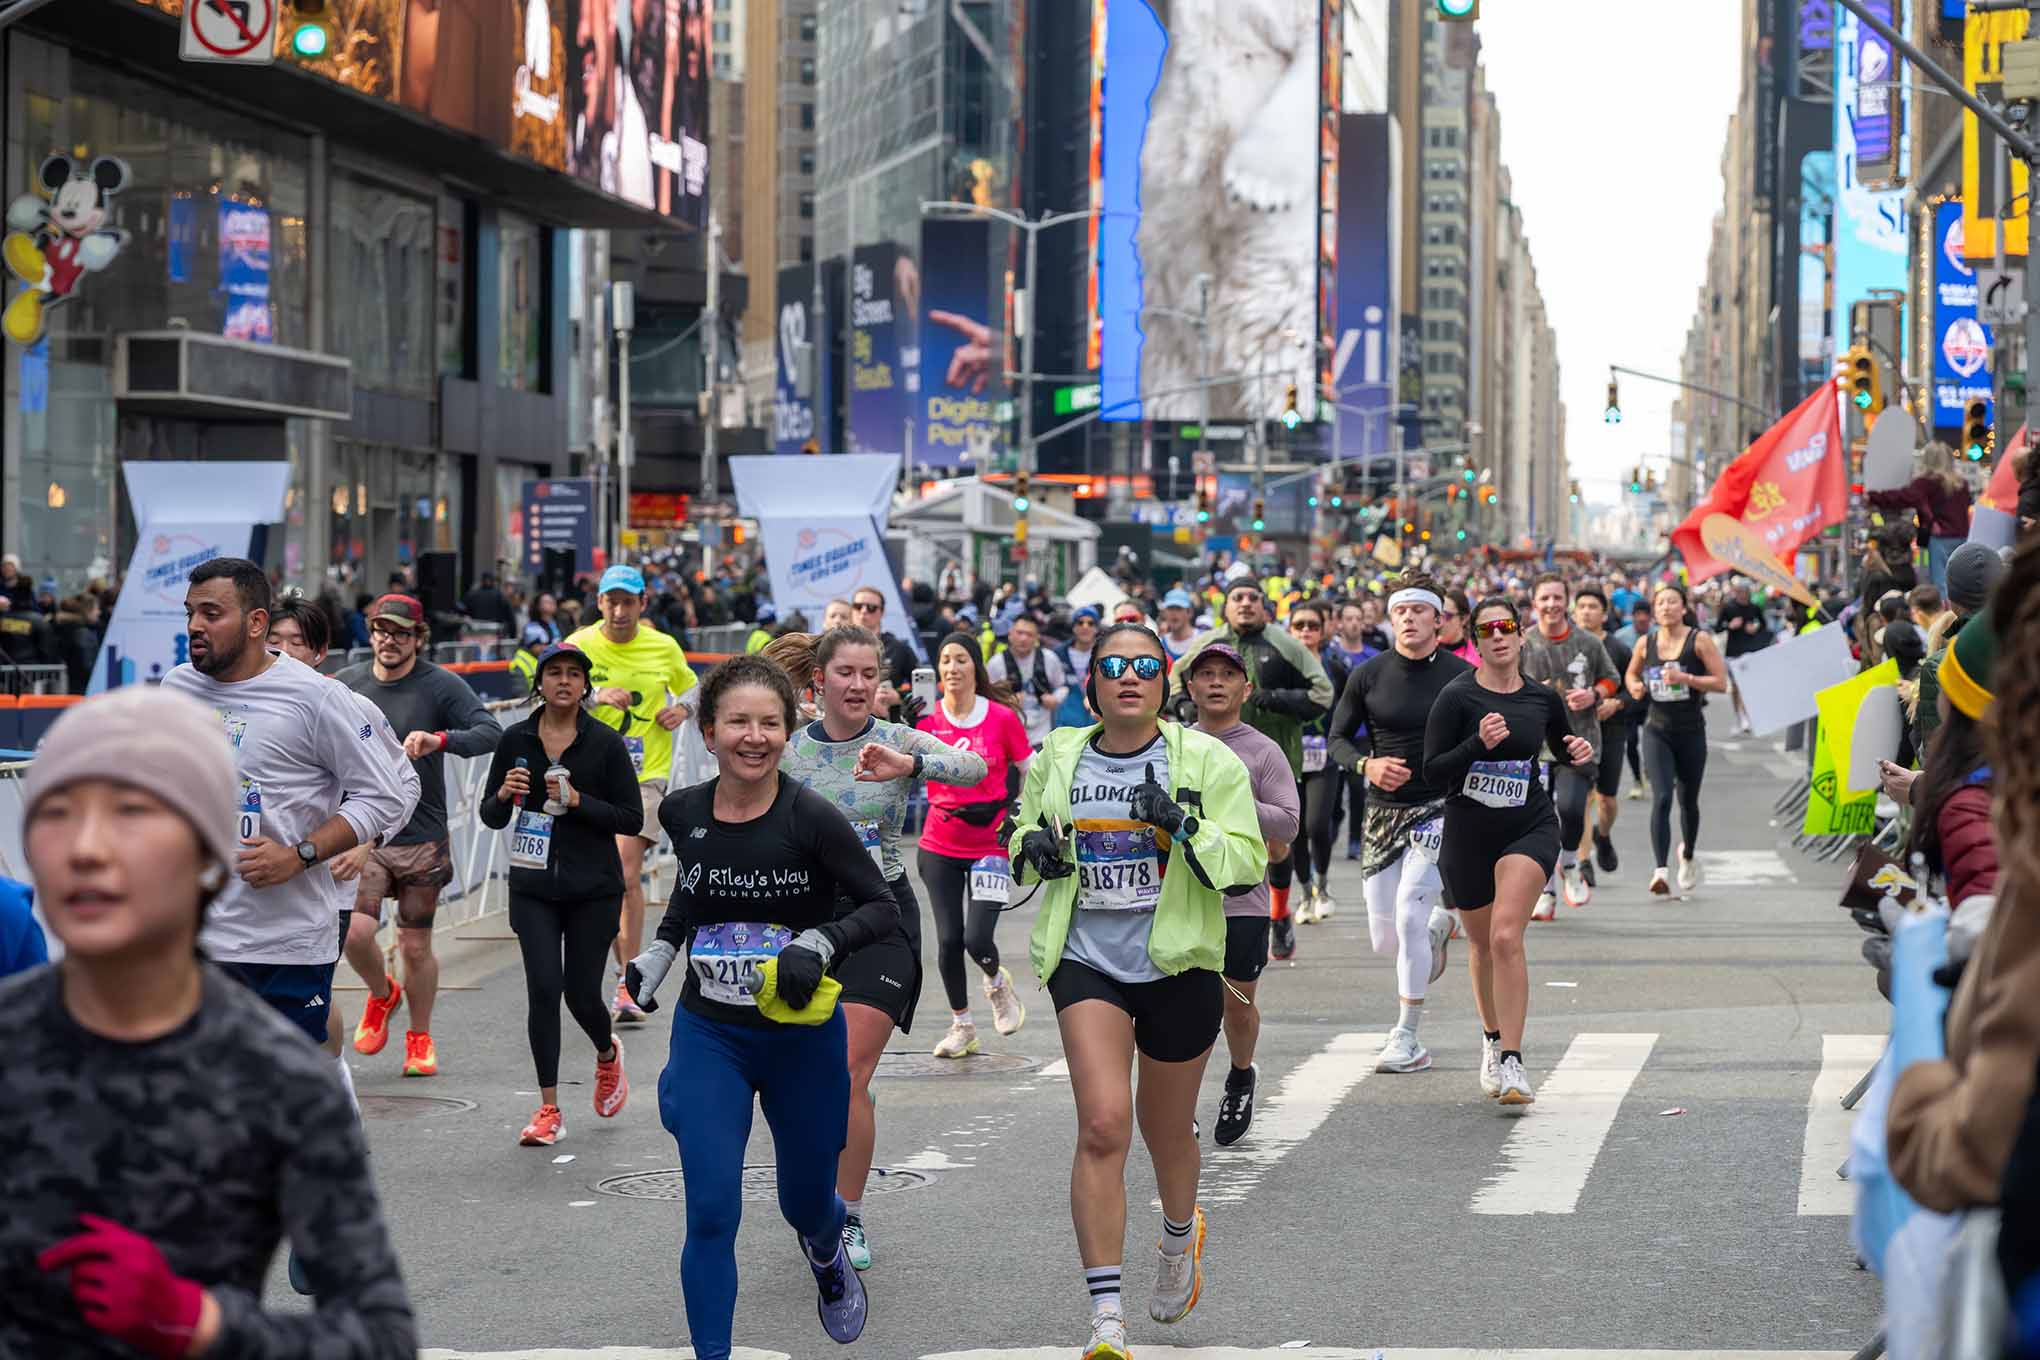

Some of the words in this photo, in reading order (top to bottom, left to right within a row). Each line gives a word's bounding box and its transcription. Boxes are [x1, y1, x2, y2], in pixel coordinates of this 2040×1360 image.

[1468, 775, 1524, 799] B21080
[1829, 801, 1875, 833] LATER
[708, 866, 768, 889] Riley's
[773, 868, 809, 885] Way
[1080, 862, 1151, 890] B18778
[709, 886, 811, 899] FOUNDATION
